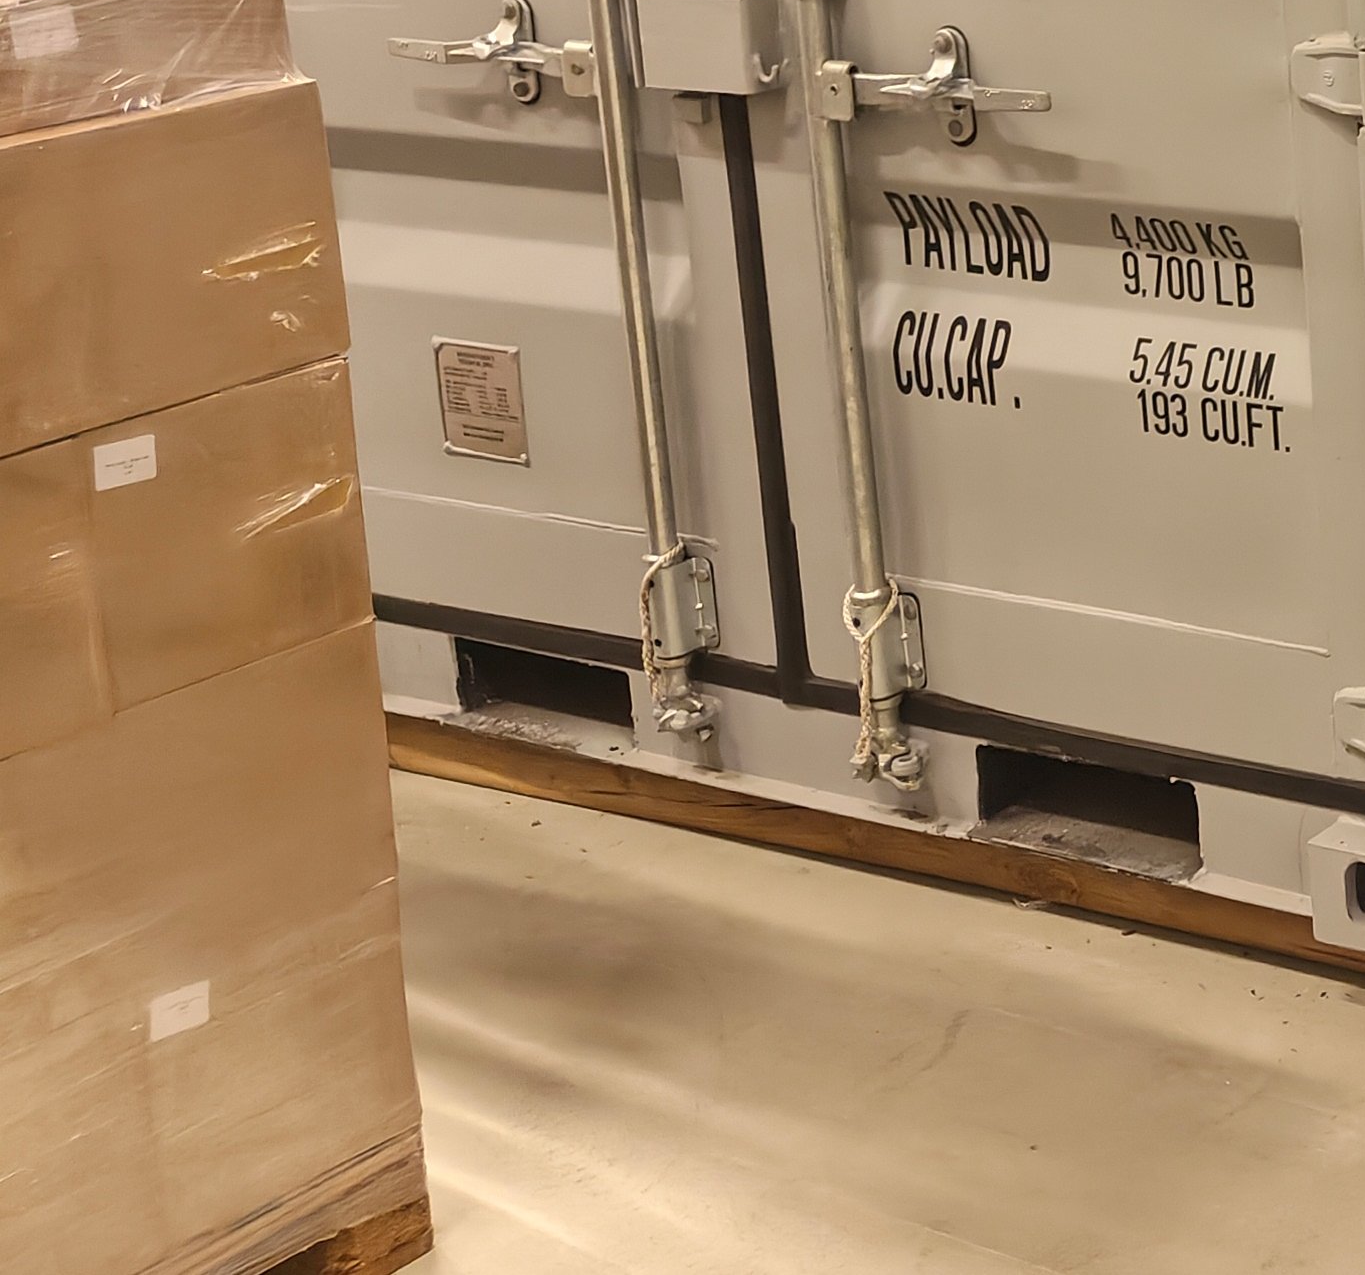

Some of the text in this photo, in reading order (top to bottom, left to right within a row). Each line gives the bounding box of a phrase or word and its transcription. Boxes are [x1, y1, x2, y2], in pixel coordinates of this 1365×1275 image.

[883, 190, 1051, 283] PAYLOAD
[1195, 221, 1250, 261] KG
[1213, 260, 1255, 309] LB
[1129, 337, 1277, 402] 5.45 CU.M.
[1137, 388, 1292, 453] 193 CU.FT.
